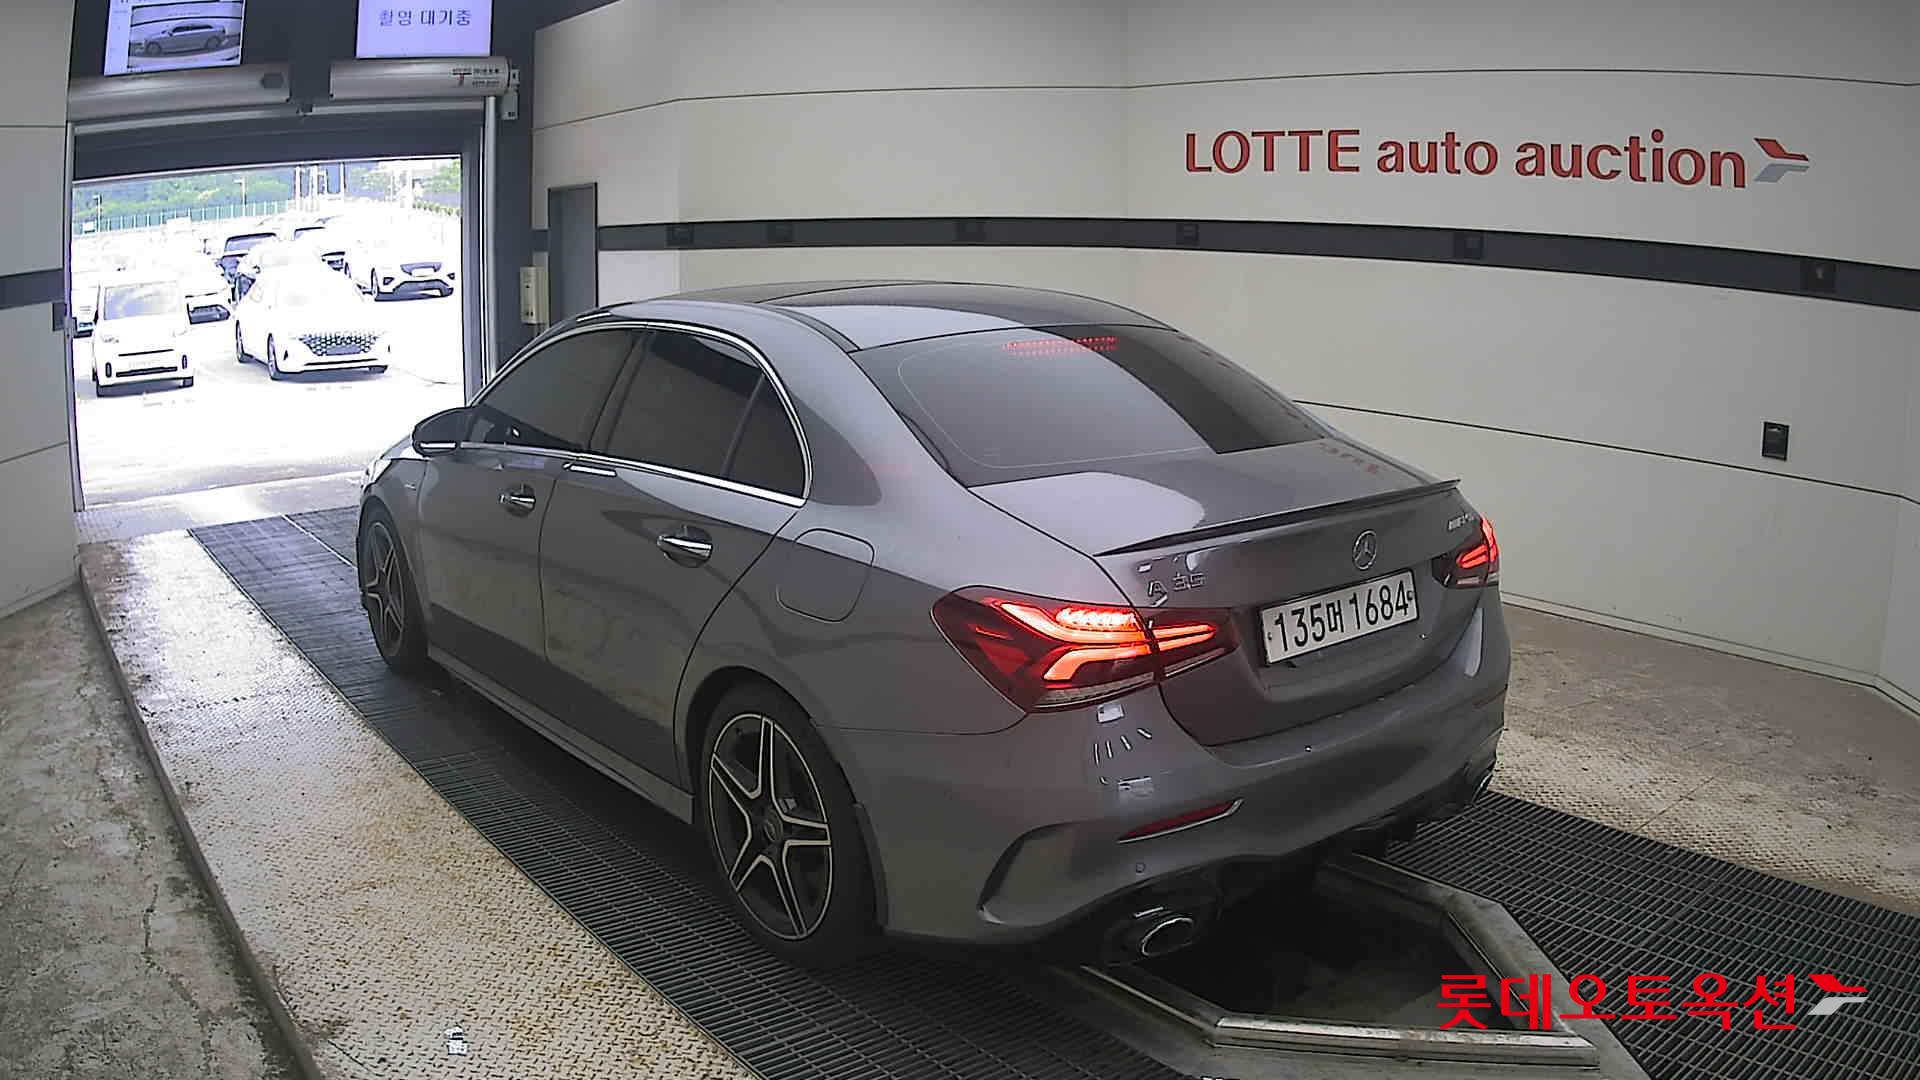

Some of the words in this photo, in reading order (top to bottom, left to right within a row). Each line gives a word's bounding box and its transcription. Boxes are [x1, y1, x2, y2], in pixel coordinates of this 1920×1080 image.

[420, 9, 471, 26] 대기중
[1185, 129, 1360, 173] LOTTE
[1377, 130, 1498, 175] auto
[1515, 128, 1747, 188] auction
[1147, 579, 1168, 598] A
[1172, 572, 1206, 592] 35
[1274, 600, 1344, 651] 135머
[1349, 580, 1409, 629] 1684
